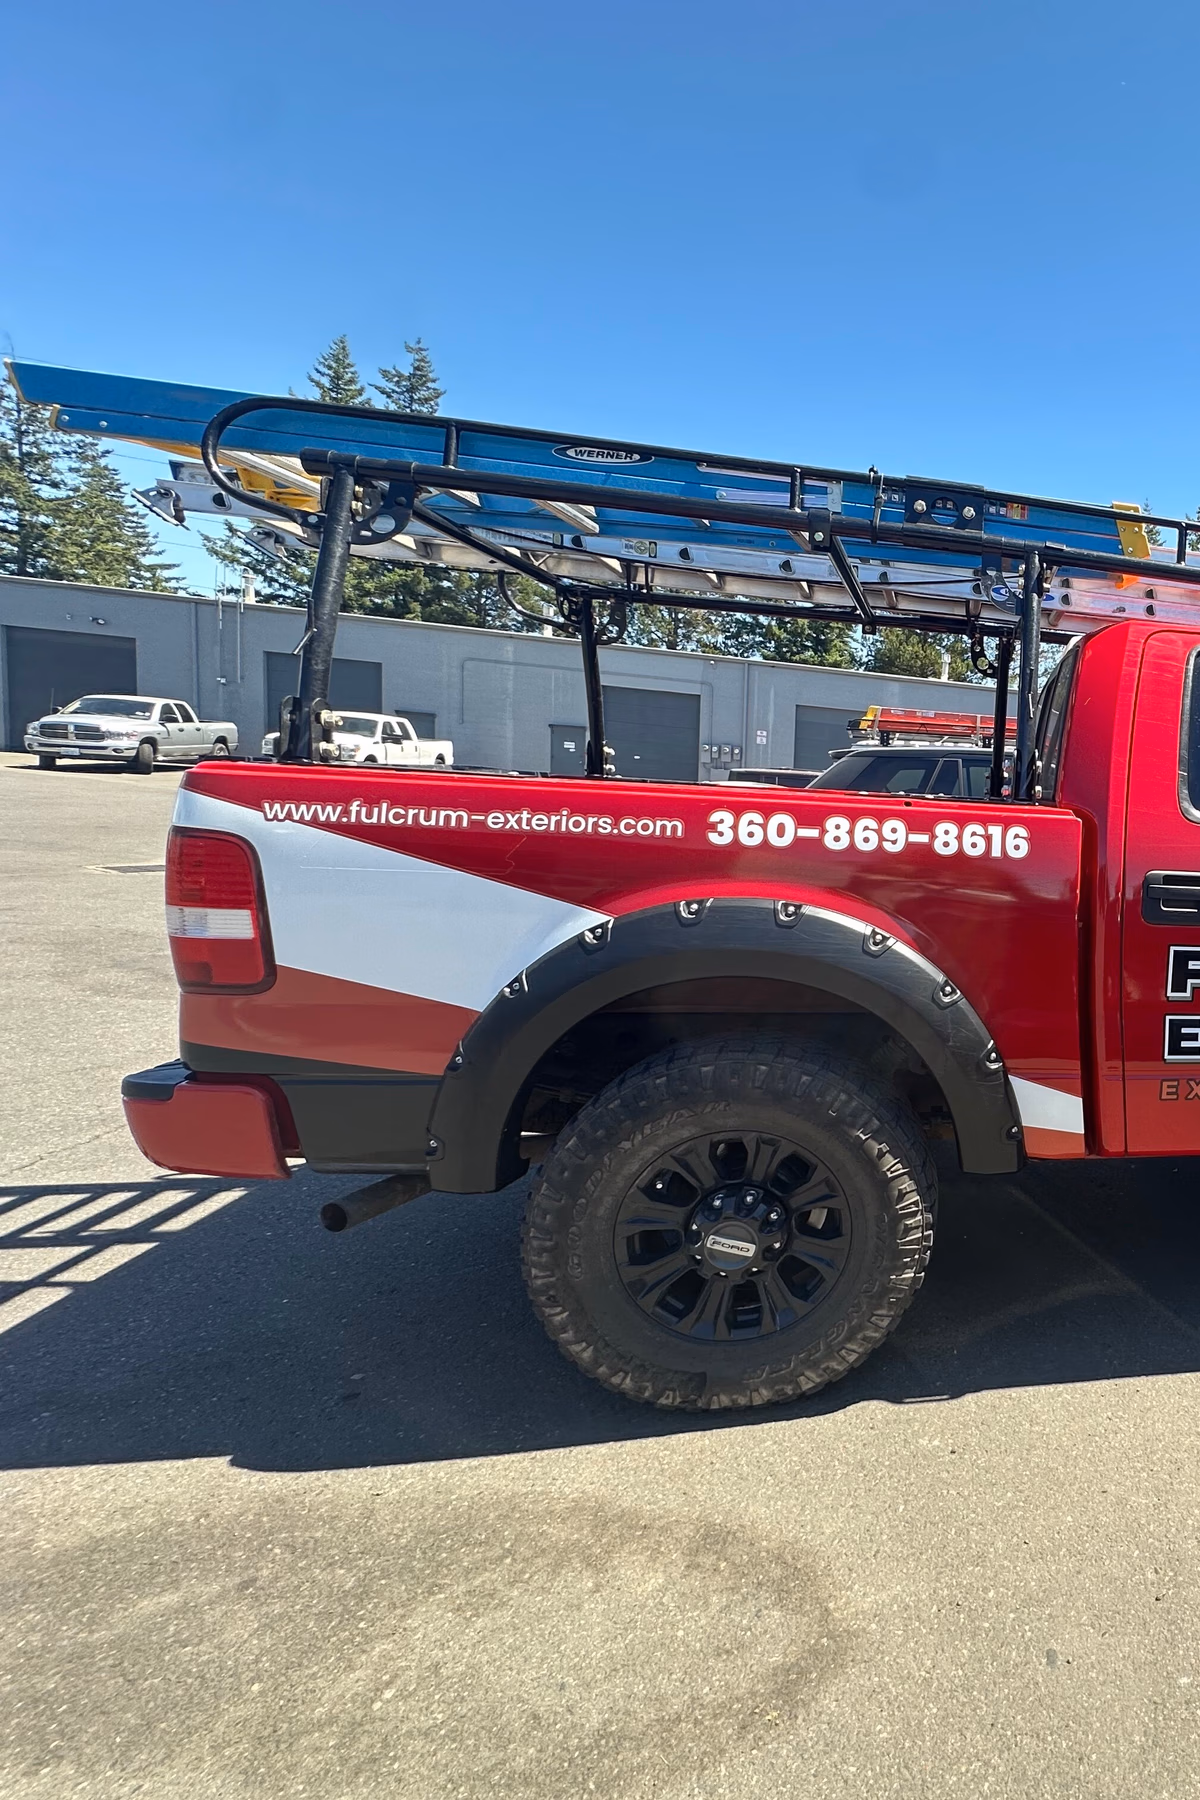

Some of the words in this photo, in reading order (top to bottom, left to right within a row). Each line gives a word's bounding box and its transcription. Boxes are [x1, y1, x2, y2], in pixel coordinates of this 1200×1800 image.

[574, 449, 634, 461] WERNER
[262, 799, 684, 839] www.fulcrum-exteriors.com
[706, 809, 1031, 860] 360-869-8616
[712, 1240, 750, 1252] FORD
